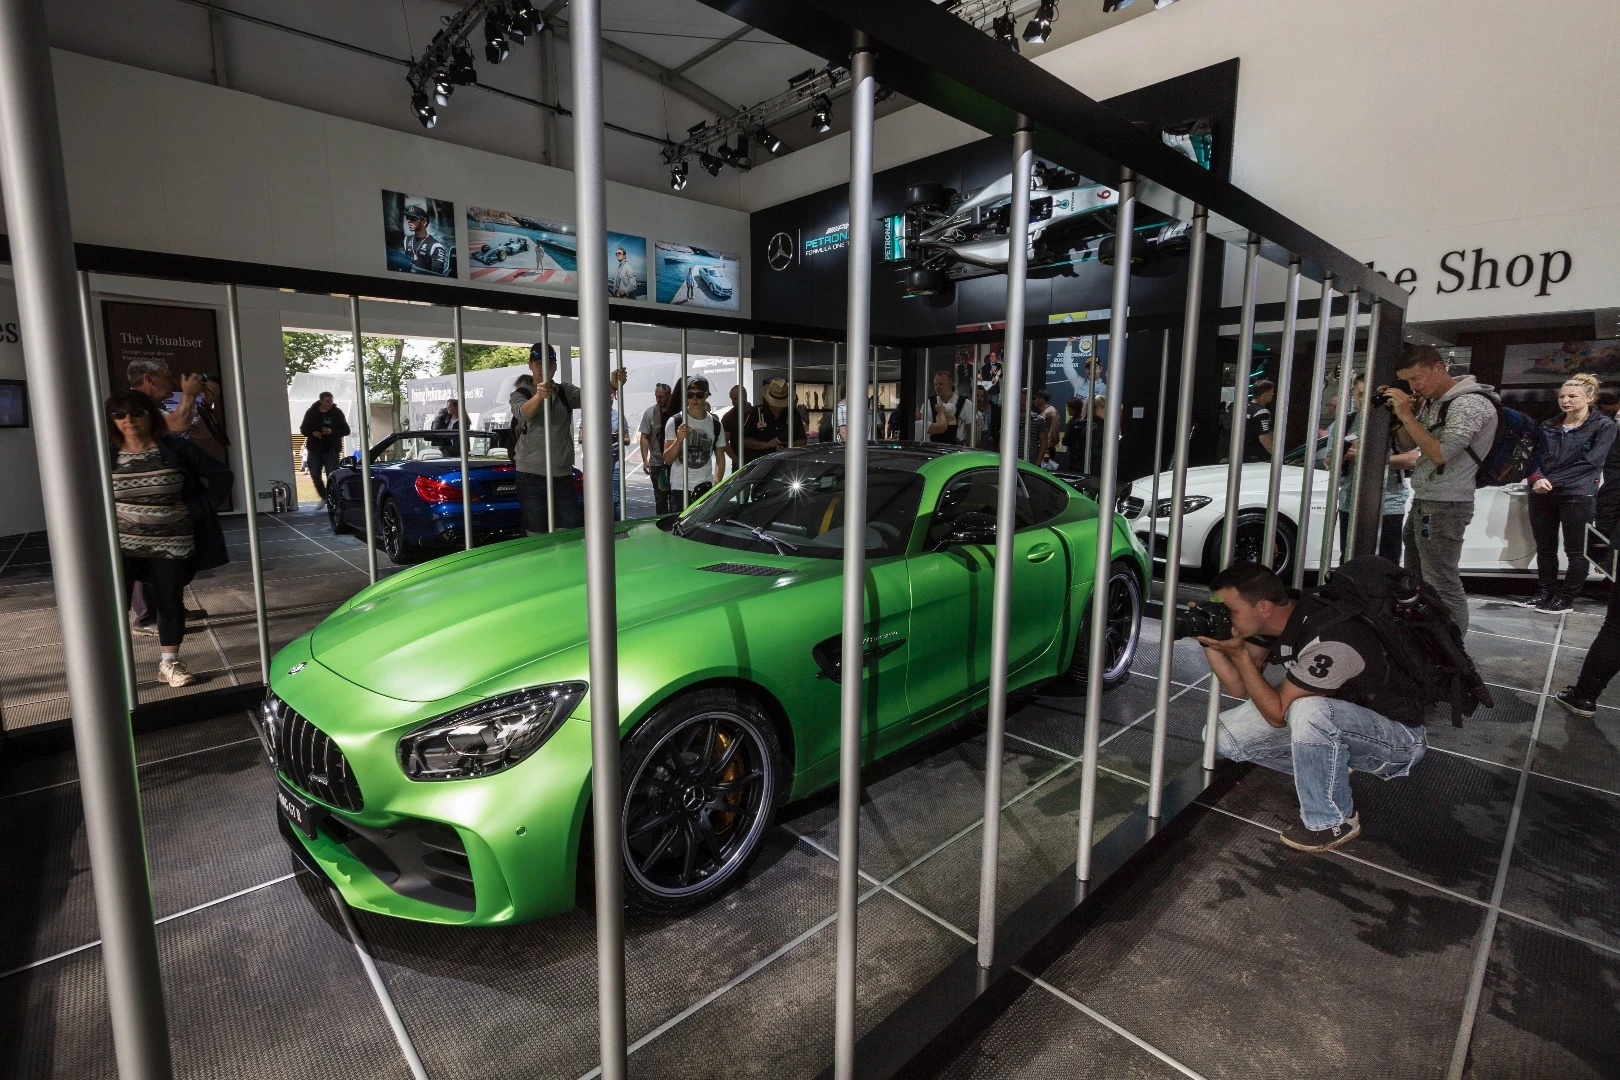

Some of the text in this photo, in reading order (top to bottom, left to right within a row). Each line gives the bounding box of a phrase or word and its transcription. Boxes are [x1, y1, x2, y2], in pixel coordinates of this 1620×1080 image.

[805, 231, 850, 250] PETRON
[1436, 247, 1572, 297] Shop
[120, 332, 203, 348] The Visualiser
[1308, 653, 1334, 679] 3
